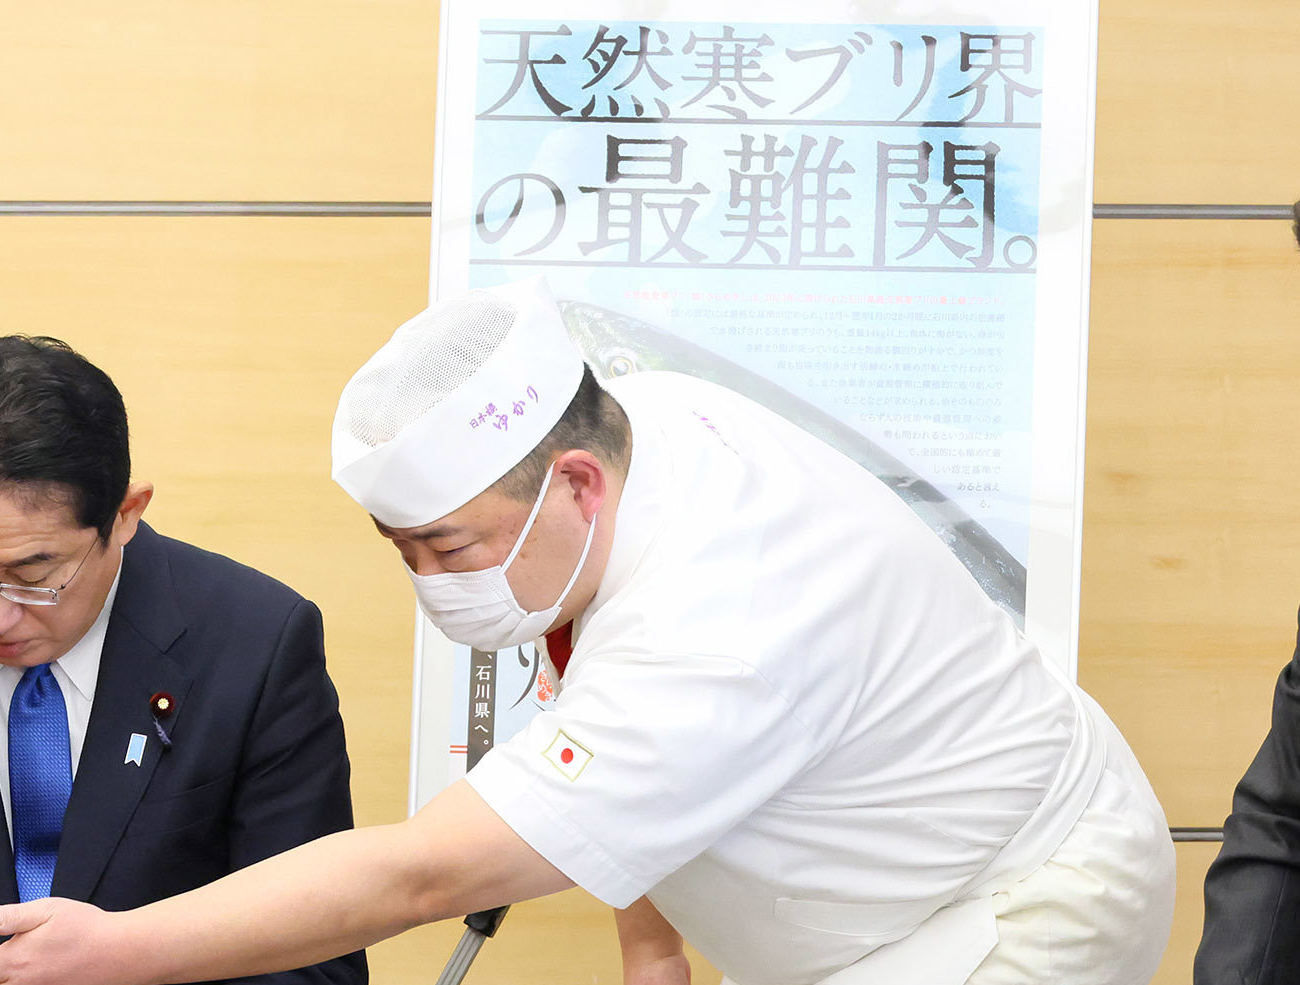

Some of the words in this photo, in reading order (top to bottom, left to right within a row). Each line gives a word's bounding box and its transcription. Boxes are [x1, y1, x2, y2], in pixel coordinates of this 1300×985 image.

[479, 23, 1043, 127] 天然寒ブリ界
[474, 133, 1038, 269] の最難関。
[492, 385, 539, 432] ゆかり
